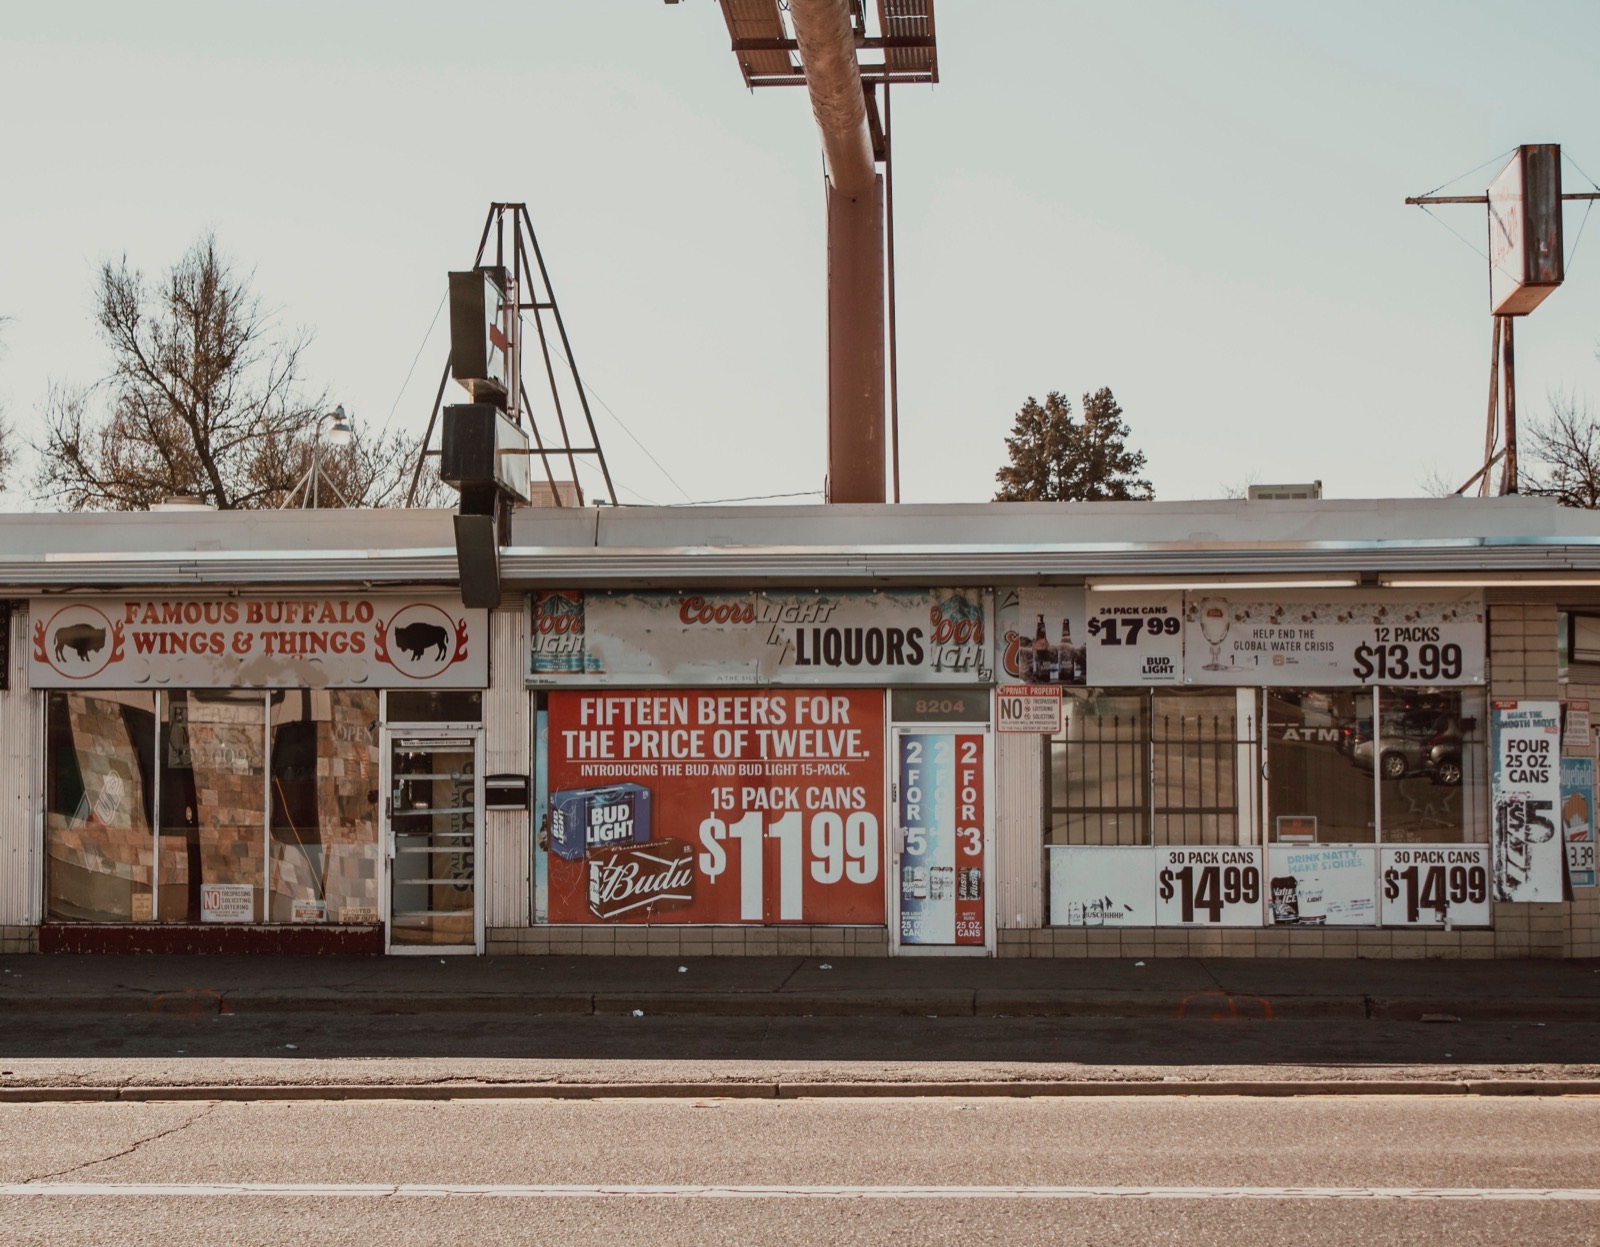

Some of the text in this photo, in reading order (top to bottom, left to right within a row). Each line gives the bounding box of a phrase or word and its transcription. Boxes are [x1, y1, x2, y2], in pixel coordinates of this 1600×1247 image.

[124, 600, 375, 625] FAMOUS BUFFALO
[679, 596, 839, 625] Coors LIGHT
[1100, 606, 1168, 615] 24 PACK CANS
[1253, 629, 1315, 639] HELP END THE
[1374, 626, 1440, 642] 12 PACKS
[132, 631, 366, 655] WINGS & THINGS
[795, 626, 924, 667] LIQUORS
[1233, 640, 1335, 651] GLOBAL WATER CRISIS
[1146, 657, 1170, 666] BUD
[1352, 641, 1463, 683] $13.99
[1142, 665, 1175, 674] LIGHT
[1005, 686, 1060, 696] PRIVATE PROPERTY
[580, 696, 850, 726] FIFTEEN BEERS FOR
[915, 699, 965, 713] 8204
[1001, 698, 1022, 720] NO
[1282, 728, 1339, 742] ATM
[561, 729, 870, 759] THE PRICE OF TWELVE.
[1507, 739, 1550, 753] FOUR
[1505, 754, 1552, 768] 25 OZ.
[580, 763, 850, 777] INTRODUCING THE BUD AND BUD LIGHT 15-PACK.
[1508, 769, 1550, 783] CANS
[1561, 764, 1591, 788] dgefield
[711, 786, 867, 810] 15 PACK CANS
[902, 741, 927, 856] 2 FOR $5
[956, 741, 982, 856] 2 FOR $3
[591, 804, 630, 827] BUD
[586, 819, 635, 843] LIGHT
[1169, 851, 1254, 864] 30 PACK CANS
[1287, 853, 1321, 865] DRINK
[1394, 850, 1480, 864] 30 PACK CANS
[1569, 846, 1594, 867] 3.39
[1288, 862, 1318, 874] MAKE
[204, 891, 220, 910] NO
[1282, 894, 1297, 904] ICE
[956, 921, 982, 929] 25 OZ.
[902, 929, 921, 937] CAN
[957, 929, 981, 937] CANS
